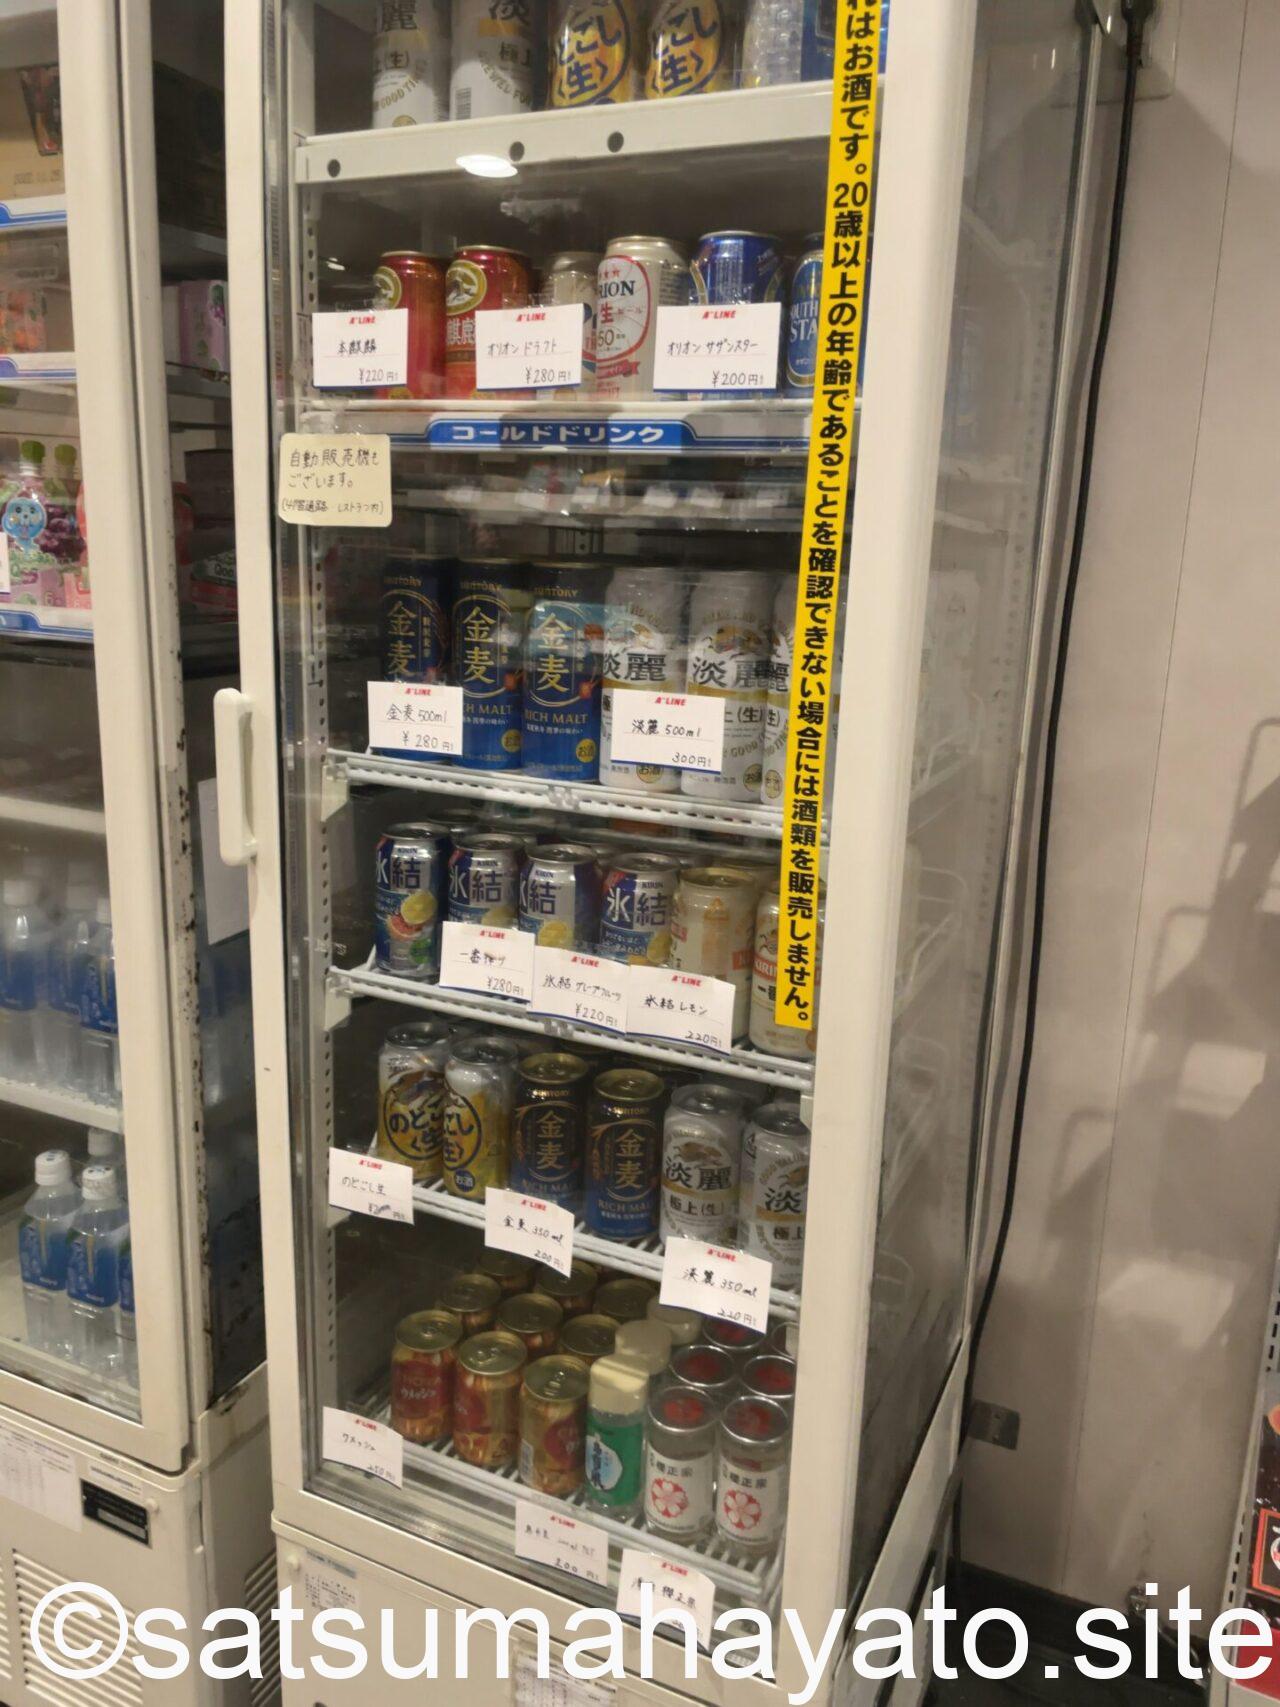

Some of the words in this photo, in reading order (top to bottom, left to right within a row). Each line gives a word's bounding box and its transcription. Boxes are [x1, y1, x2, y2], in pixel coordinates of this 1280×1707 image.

[452, 424, 664, 443] コールドドリンク
[388, 601, 416, 677] 金麦
[462, 606, 496, 684] 金麦
[536, 613, 572, 692] 金麦
[386, 704, 415, 722] 金麦
[552, 712, 588, 723] MALT
[607, 888, 668, 927] 氷結
[536, 1111, 565, 1170] 金麦
[616, 1128, 645, 1190] 金麦
[665, 1158, 731, 1191] 淡麗
